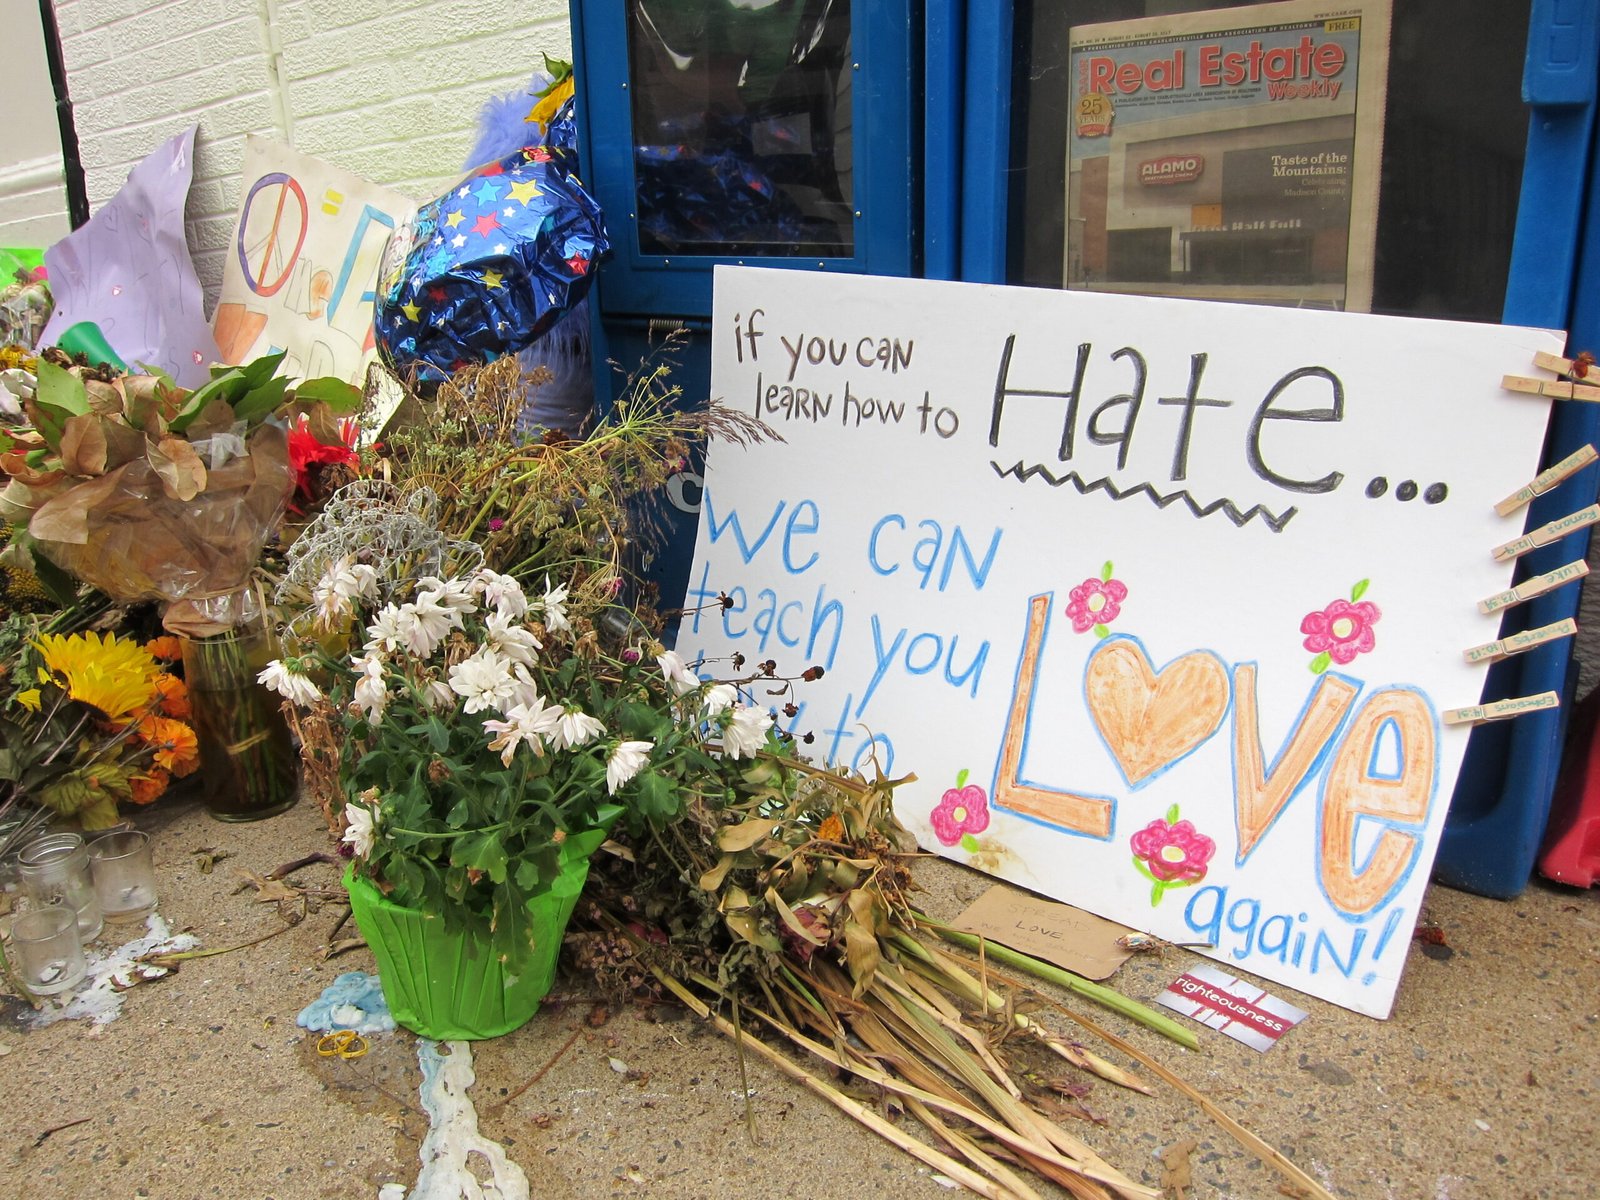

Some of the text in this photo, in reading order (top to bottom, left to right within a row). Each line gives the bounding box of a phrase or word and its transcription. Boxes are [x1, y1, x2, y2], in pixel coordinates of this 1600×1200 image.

[1329, 20, 1355, 31] FREE
[1089, 35, 1345, 95] Real Estate
[1267, 77, 1341, 100] Weekly
[1081, 99, 1102, 116] 25
[1142, 159, 1197, 176] ALAMO
[1271, 152, 1348, 166] Taste of the
[1272, 164, 1347, 177] Mountains:
[734, 308, 765, 363] if
[780, 333, 848, 382] you
[842, 381, 906, 428] how
[916, 390, 959, 439] to
[1547, 510, 1597, 534] Romans
[1545, 564, 1581, 584] Luke
[688, 560, 844, 672] teach
[855, 613, 991, 721] you
[1513, 622, 1571, 645] Proverbs
[1007, 903, 1090, 933] SPREAD
[1174, 975, 1285, 1033] righteousness
